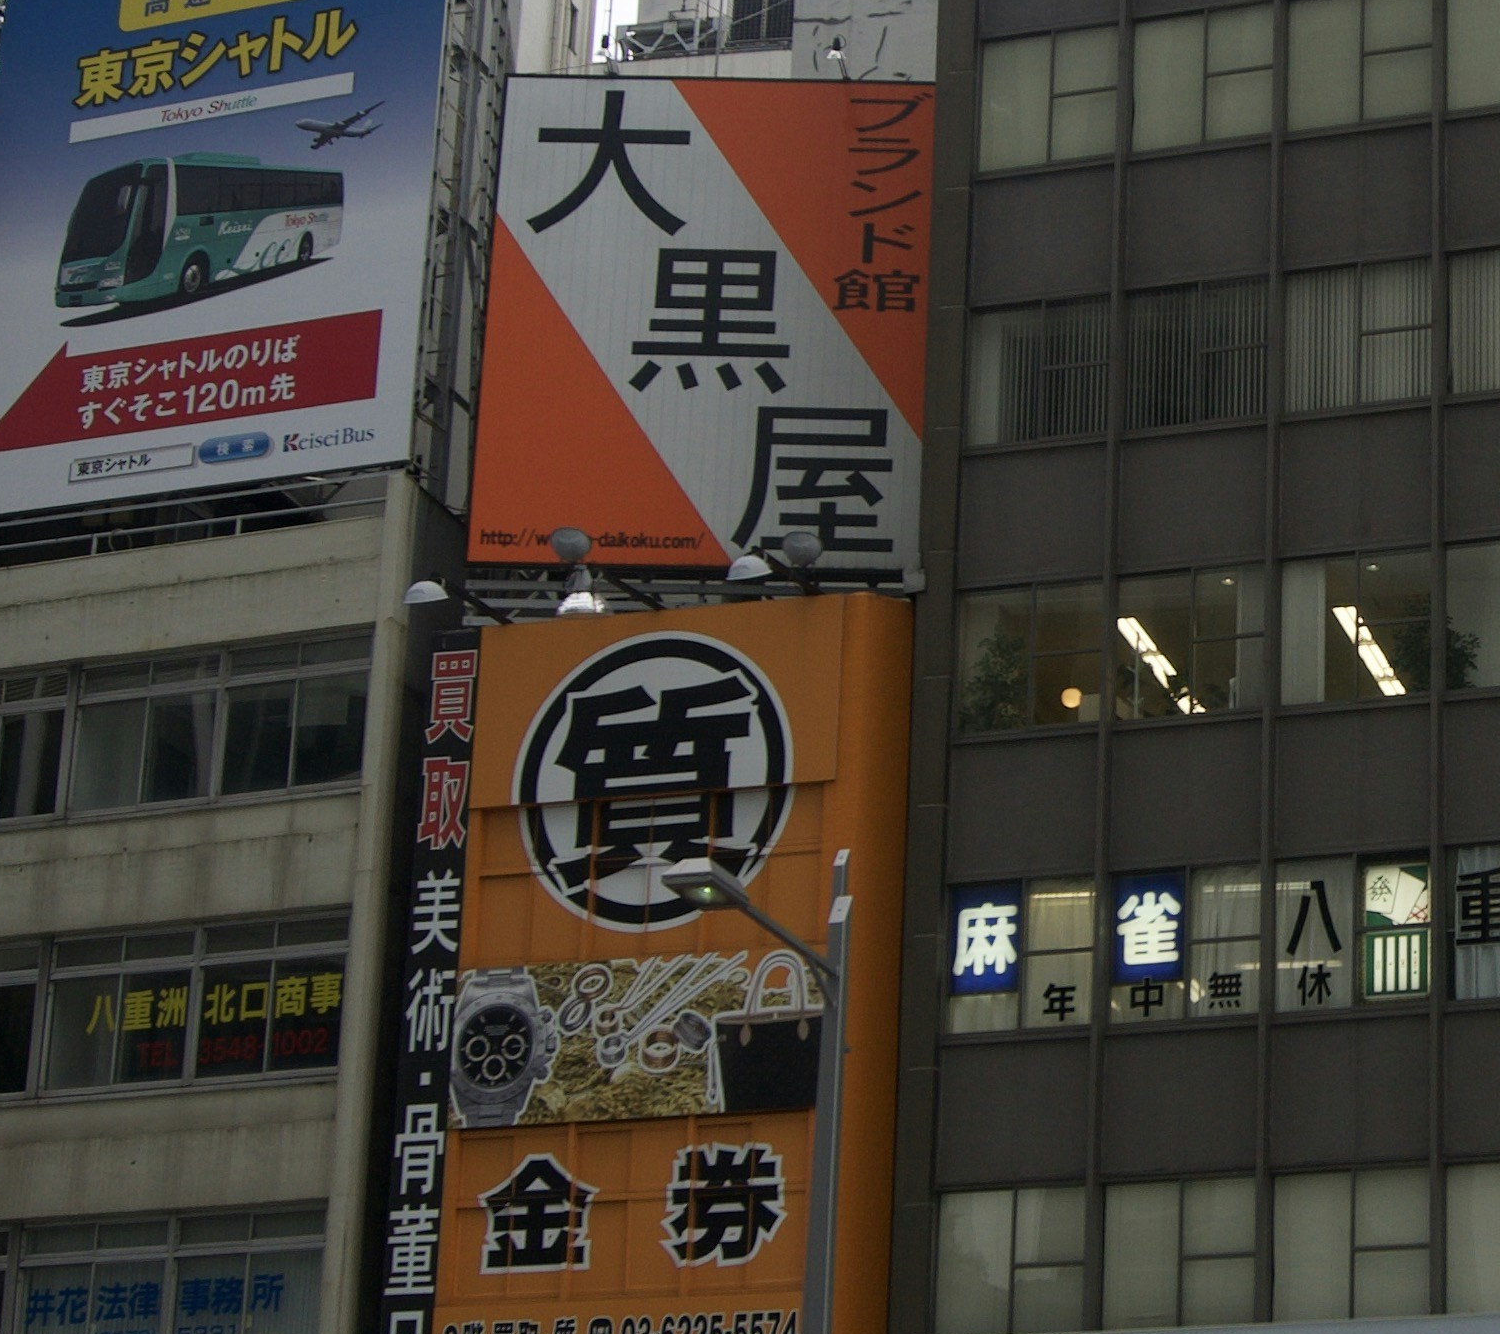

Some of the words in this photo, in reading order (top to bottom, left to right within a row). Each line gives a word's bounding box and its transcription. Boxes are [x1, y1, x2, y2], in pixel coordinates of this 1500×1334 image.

[74, 8, 357, 109] 東京シャトル
[161, 105, 204, 123] Tokyo
[833, 91, 932, 312] ブランド館
[526, 90, 894, 552] 大黒屋
[80, 334, 300, 394] 東京シャトルのりば
[77, 373, 296, 430] すぐそこ120m先
[77, 454, 152, 476] 東京シャトル
[216, 439, 255, 455] 検索
[283, 430, 338, 453] Keisei
[342, 427, 375, 445] Bus
[548, 669, 758, 896] 質
[952, 888, 1182, 978] 麻雀
[85, 972, 343, 1035] 八重洲北口商事
[1042, 962, 1334, 1024] 年中無休
[137, 1039, 179, 1067] TEL
[478, 1143, 788, 1275] 金券
[25, 1273, 284, 1326] 井花法律事務所
